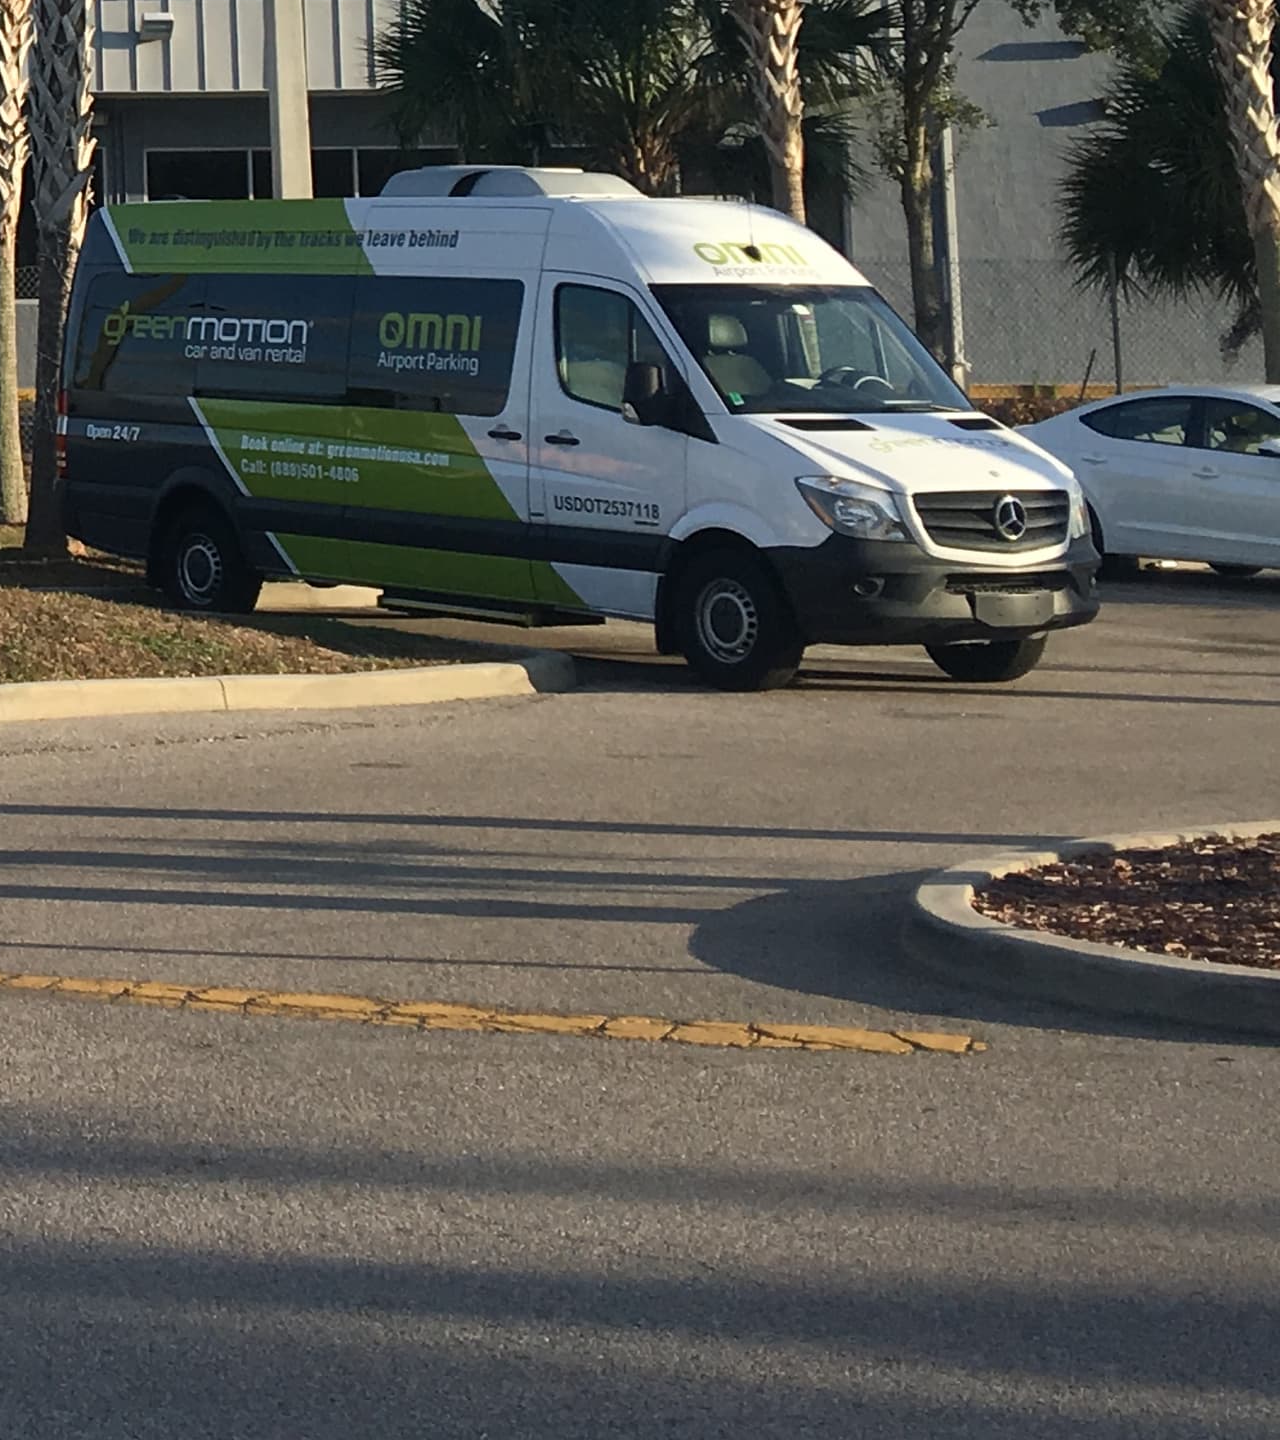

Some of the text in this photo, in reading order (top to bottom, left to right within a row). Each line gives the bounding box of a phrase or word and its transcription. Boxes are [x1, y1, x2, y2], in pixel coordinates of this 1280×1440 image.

[149, 231, 170, 246] are
[172, 229, 257, 251] distinguished
[256, 229, 272, 251] by
[274, 229, 297, 248] the
[299, 229, 341, 248] tracks
[344, 232, 365, 248] we
[366, 229, 406, 248] leave
[407, 229, 460, 249] behind
[184, 344, 307, 363] car and van rental
[377, 351, 480, 376] Airport Parking
[86, 423, 141, 442] Open 24/7
[240, 434, 268, 451] Book
[270, 437, 306, 454] online
[240, 458, 267, 475] Call:
